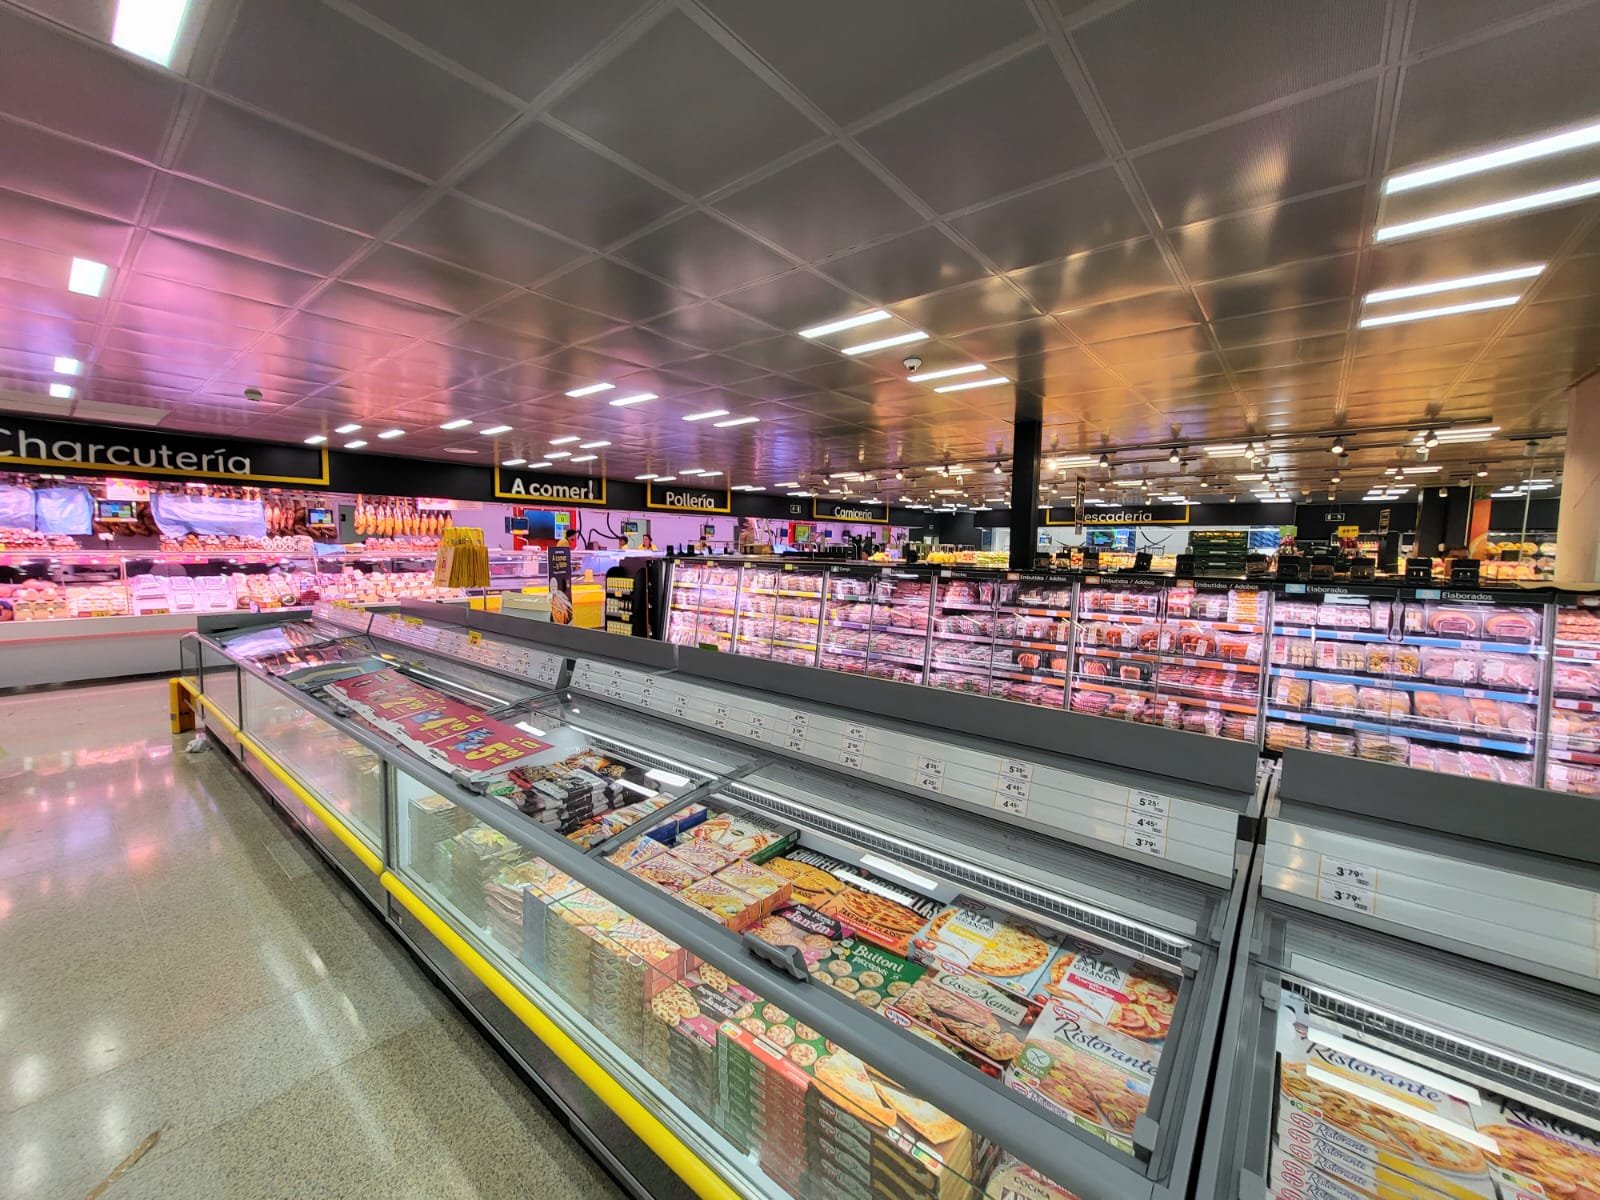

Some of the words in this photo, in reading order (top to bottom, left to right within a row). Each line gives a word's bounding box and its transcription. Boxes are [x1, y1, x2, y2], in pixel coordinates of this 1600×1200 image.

[511, 477, 526, 495] A
[528, 479, 594, 500] comer!
[665, 491, 715, 509] Pollería
[834, 506, 872, 519] Carnicería
[1083, 510, 1152, 522] escadería
[1306, 586, 1348, 594] Elaborados
[1441, 591, 1493, 601] Elaborados
[785, 910, 831, 935] Jamón
[850, 944, 904, 973] Buitoni
[939, 974, 970, 994] Casa
[1073, 964, 1120, 986] GRANDE
[1054, 1016, 1157, 1077] Ristorante
[1306, 1042, 1442, 1104] Ristorante
[1315, 1121, 1369, 1154] Ristorante
[1312, 1137, 1366, 1170] Ristorante
[1313, 1153, 1367, 1187] Ristorante
